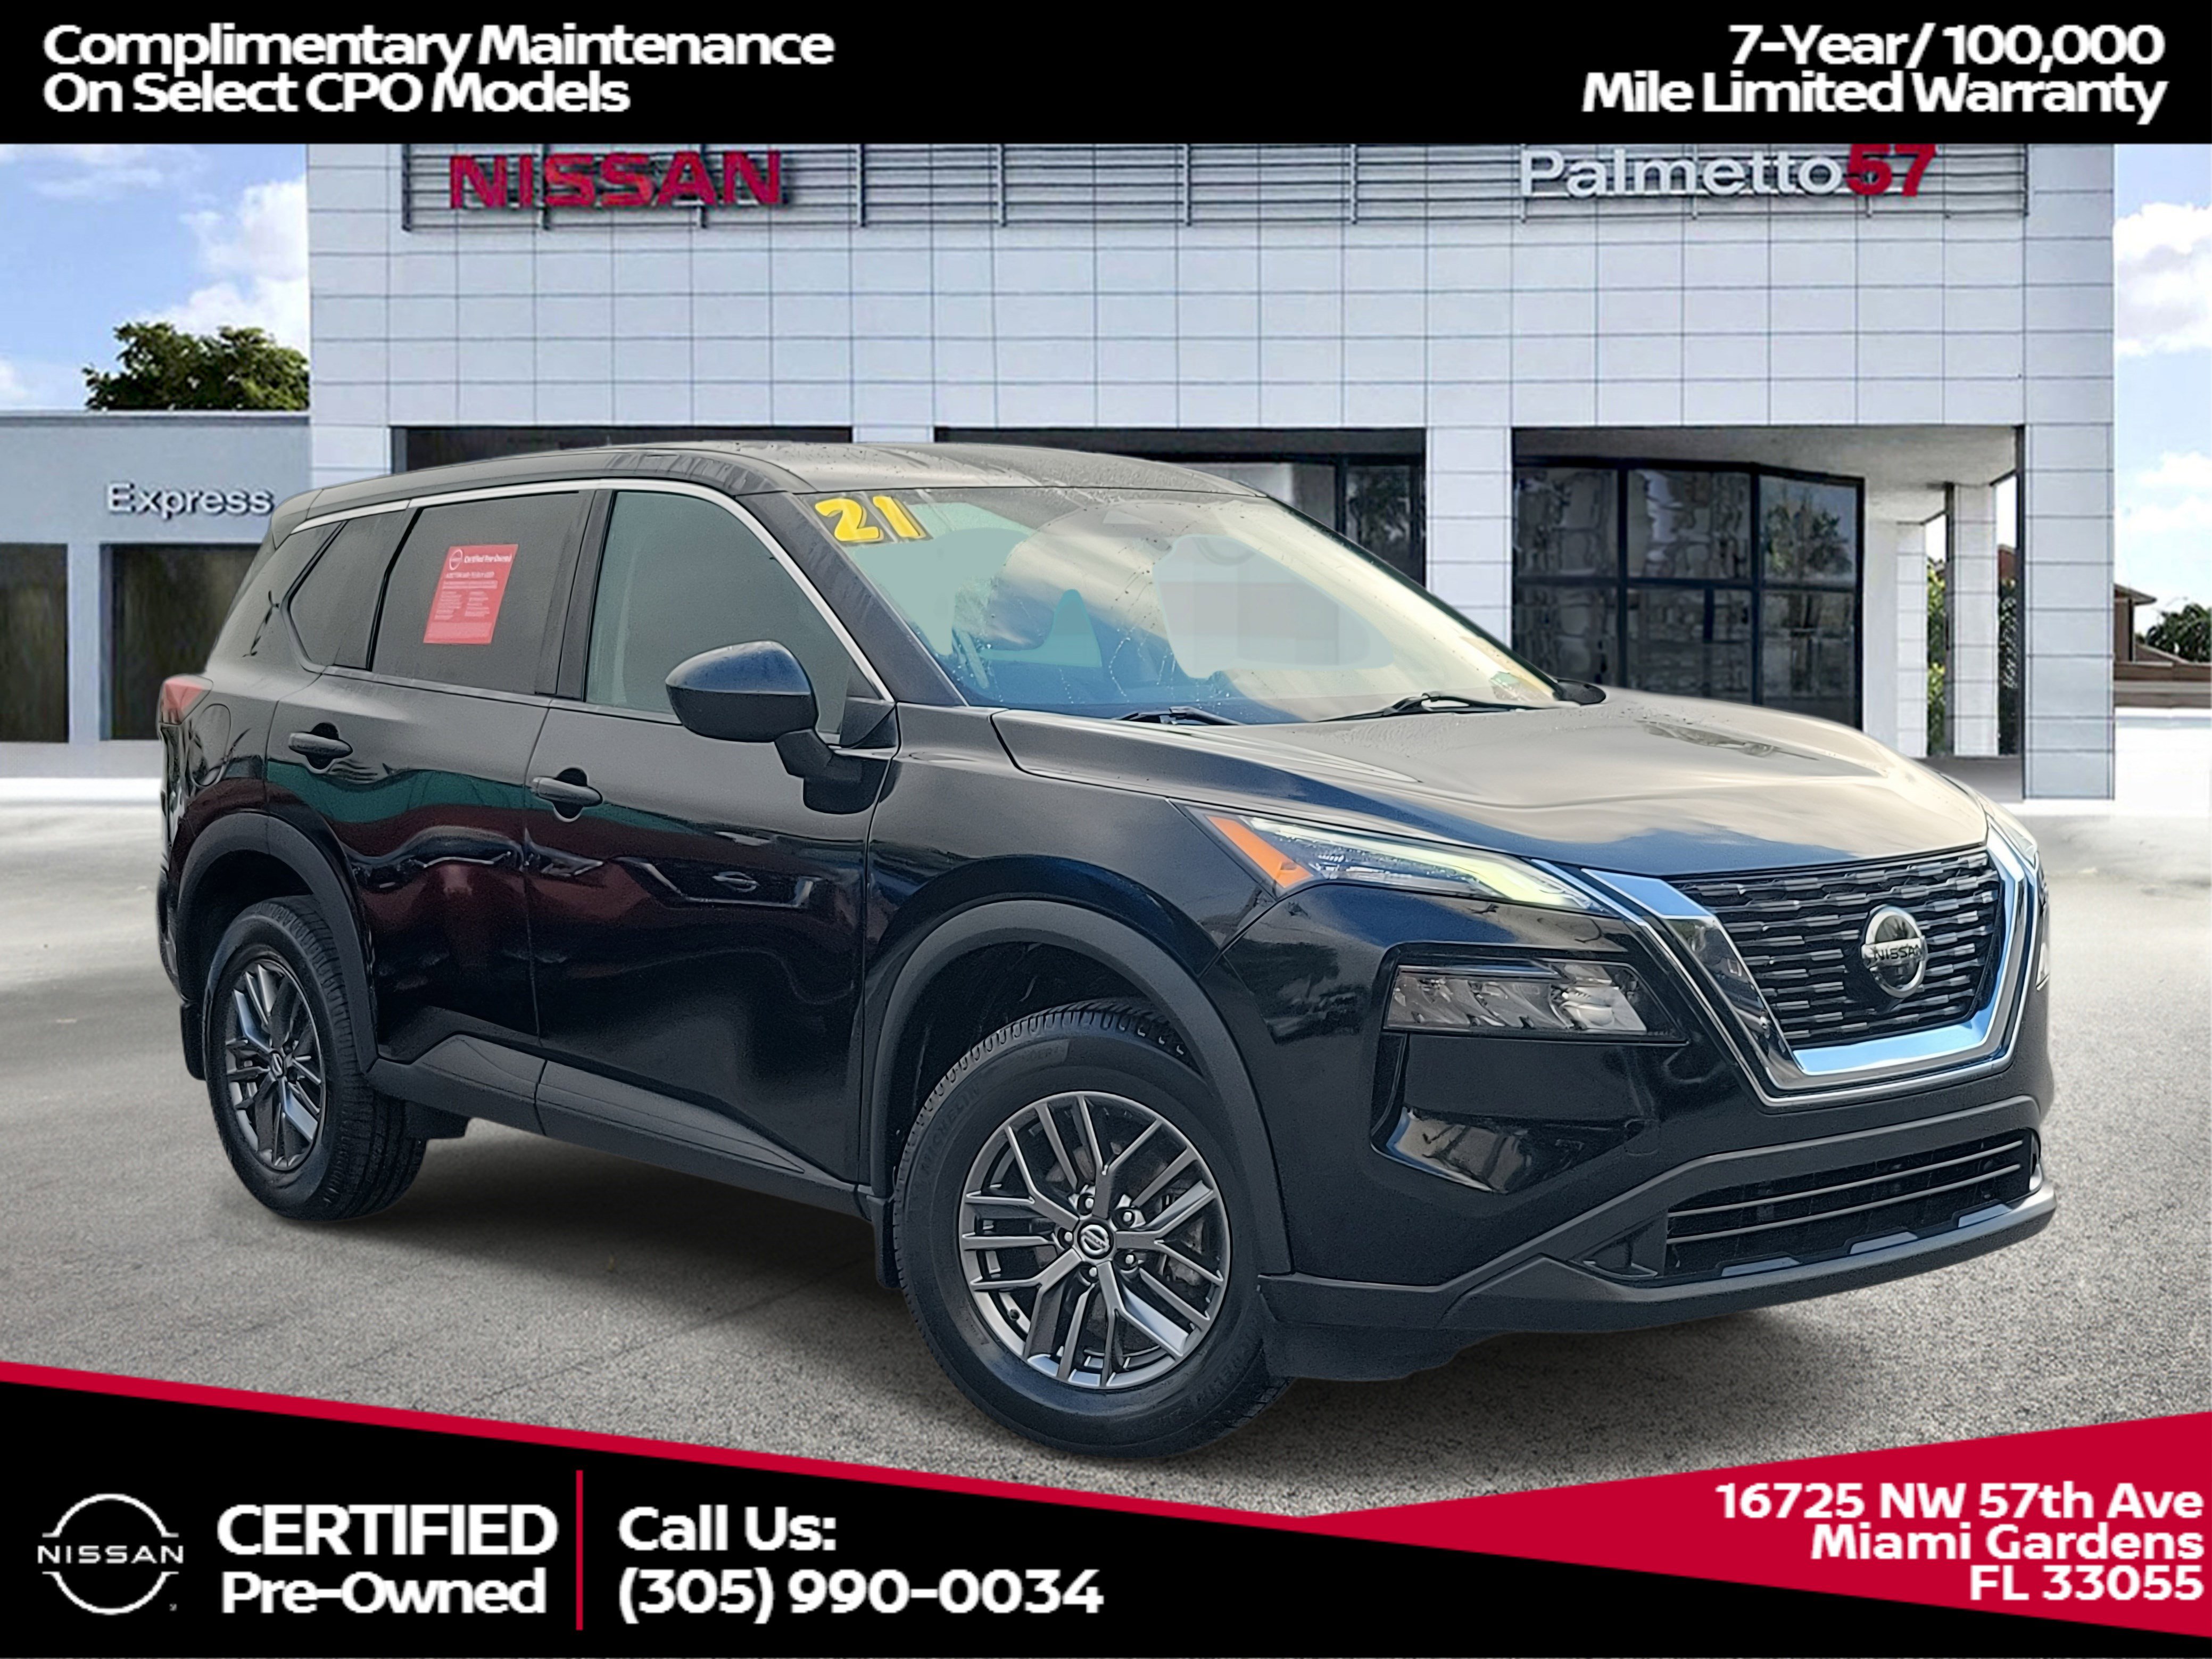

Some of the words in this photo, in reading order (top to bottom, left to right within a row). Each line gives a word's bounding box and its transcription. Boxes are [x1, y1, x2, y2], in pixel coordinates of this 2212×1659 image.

[450, 151, 781, 209] NISSAN
[108, 483, 275, 519] Express
[815, 496, 927, 543] 21
[1874, 944, 1923, 960] NISSAN
